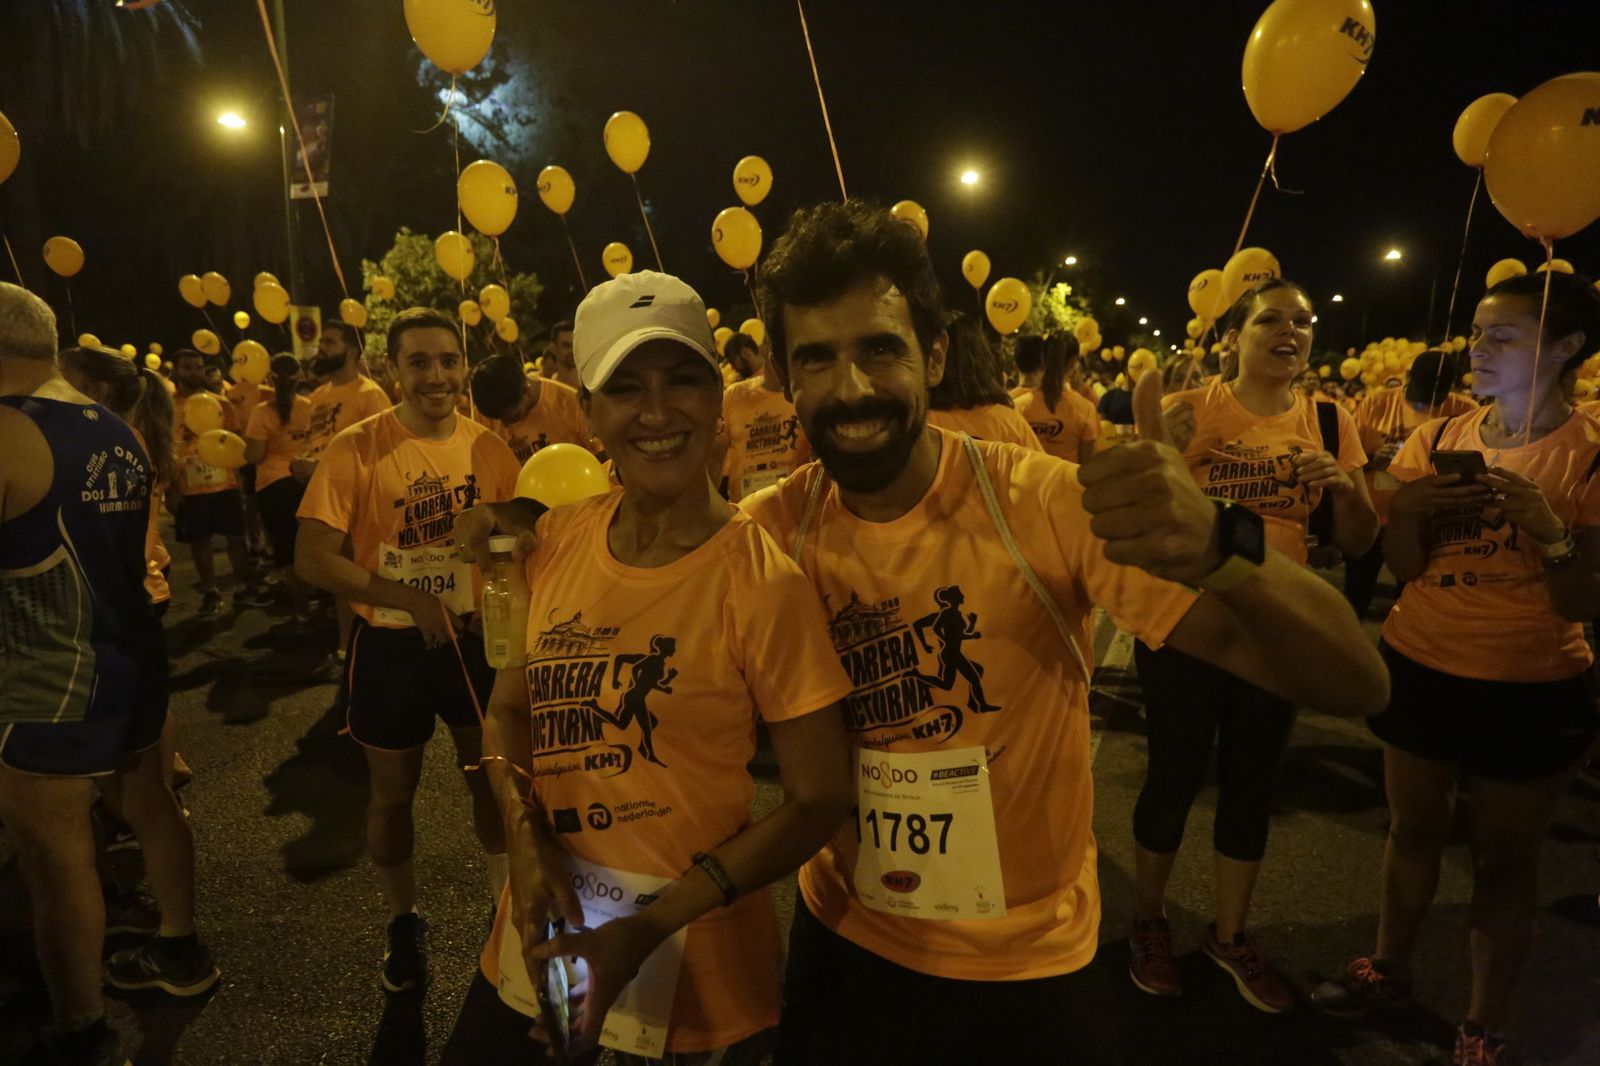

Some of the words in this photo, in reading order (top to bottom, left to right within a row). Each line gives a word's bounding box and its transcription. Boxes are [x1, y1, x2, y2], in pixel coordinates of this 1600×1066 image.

[1580, 107, 1600, 127] K
[1243, 272, 1270, 282] KH7
[1208, 459, 1277, 483] CARRERA
[81, 488, 105, 503] DOS
[99, 500, 145, 514] HERMAN
[404, 492, 453, 524] CARRERA
[527, 661, 608, 705] CARRERA
[531, 706, 606, 752] OCTURNA
[911, 713, 954, 740] KH7
[613, 800, 656, 814] nationae
[851, 803, 954, 855] 11787
